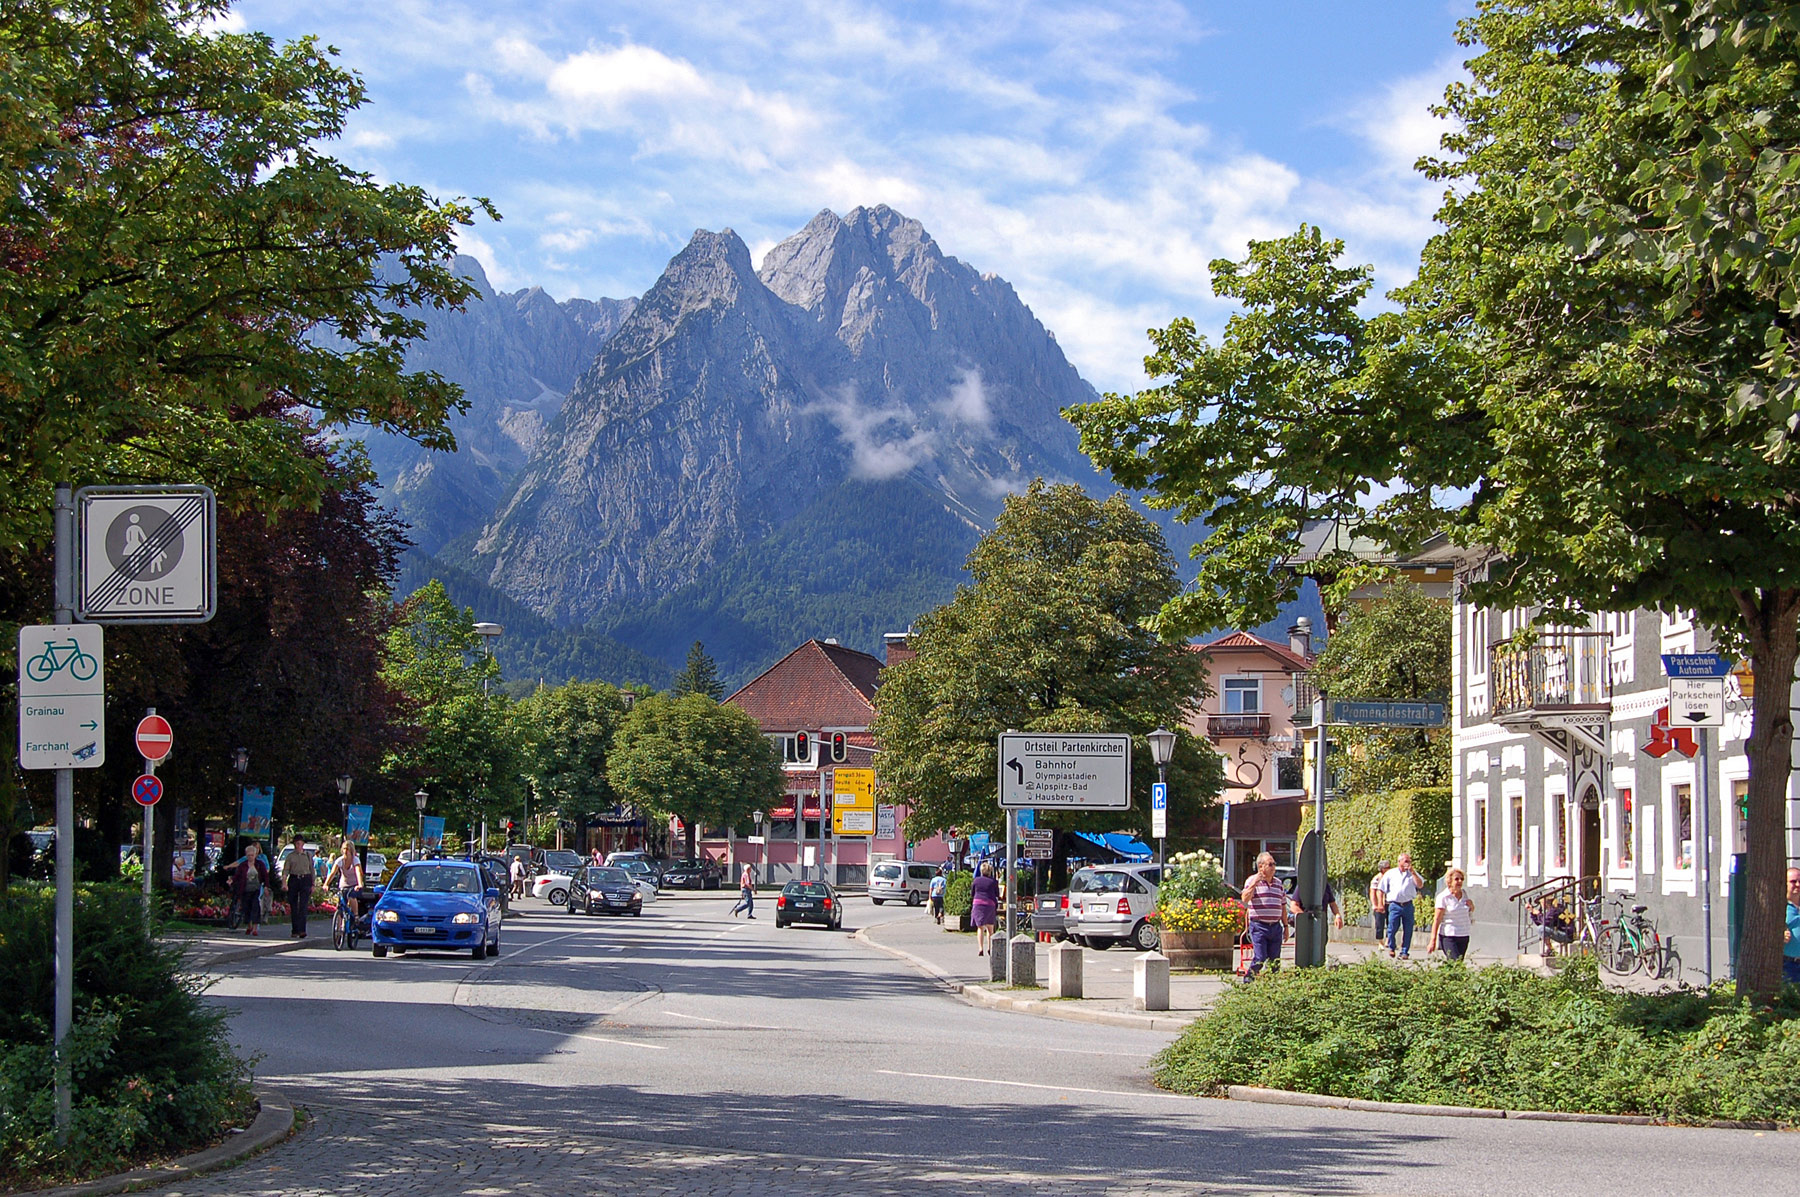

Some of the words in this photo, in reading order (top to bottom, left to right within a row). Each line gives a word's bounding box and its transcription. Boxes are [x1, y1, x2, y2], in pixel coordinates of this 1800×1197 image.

[115, 587, 174, 606] ZONE
[1670, 656, 1716, 666] Parkschein
[1679, 666, 1714, 675] Automat
[1687, 681, 1705, 689] Hier
[1672, 691, 1721, 700] Parkschein
[1685, 701, 1708, 709] lösen
[26, 706, 65, 716] Grainau
[1342, 705, 1435, 720] Promenadestraße
[26, 742, 69, 752] Farchant
[1024, 741, 1057, 753] Ortsteil
[1062, 741, 1123, 753] Partenkirchen
[1035, 760, 1076, 769] Bahnhof
[1035, 772, 1097, 781] Olympiastadien
[1035, 783, 1087, 792] Alpspitz-Bad
[1035, 793, 1074, 802] Hausberg
